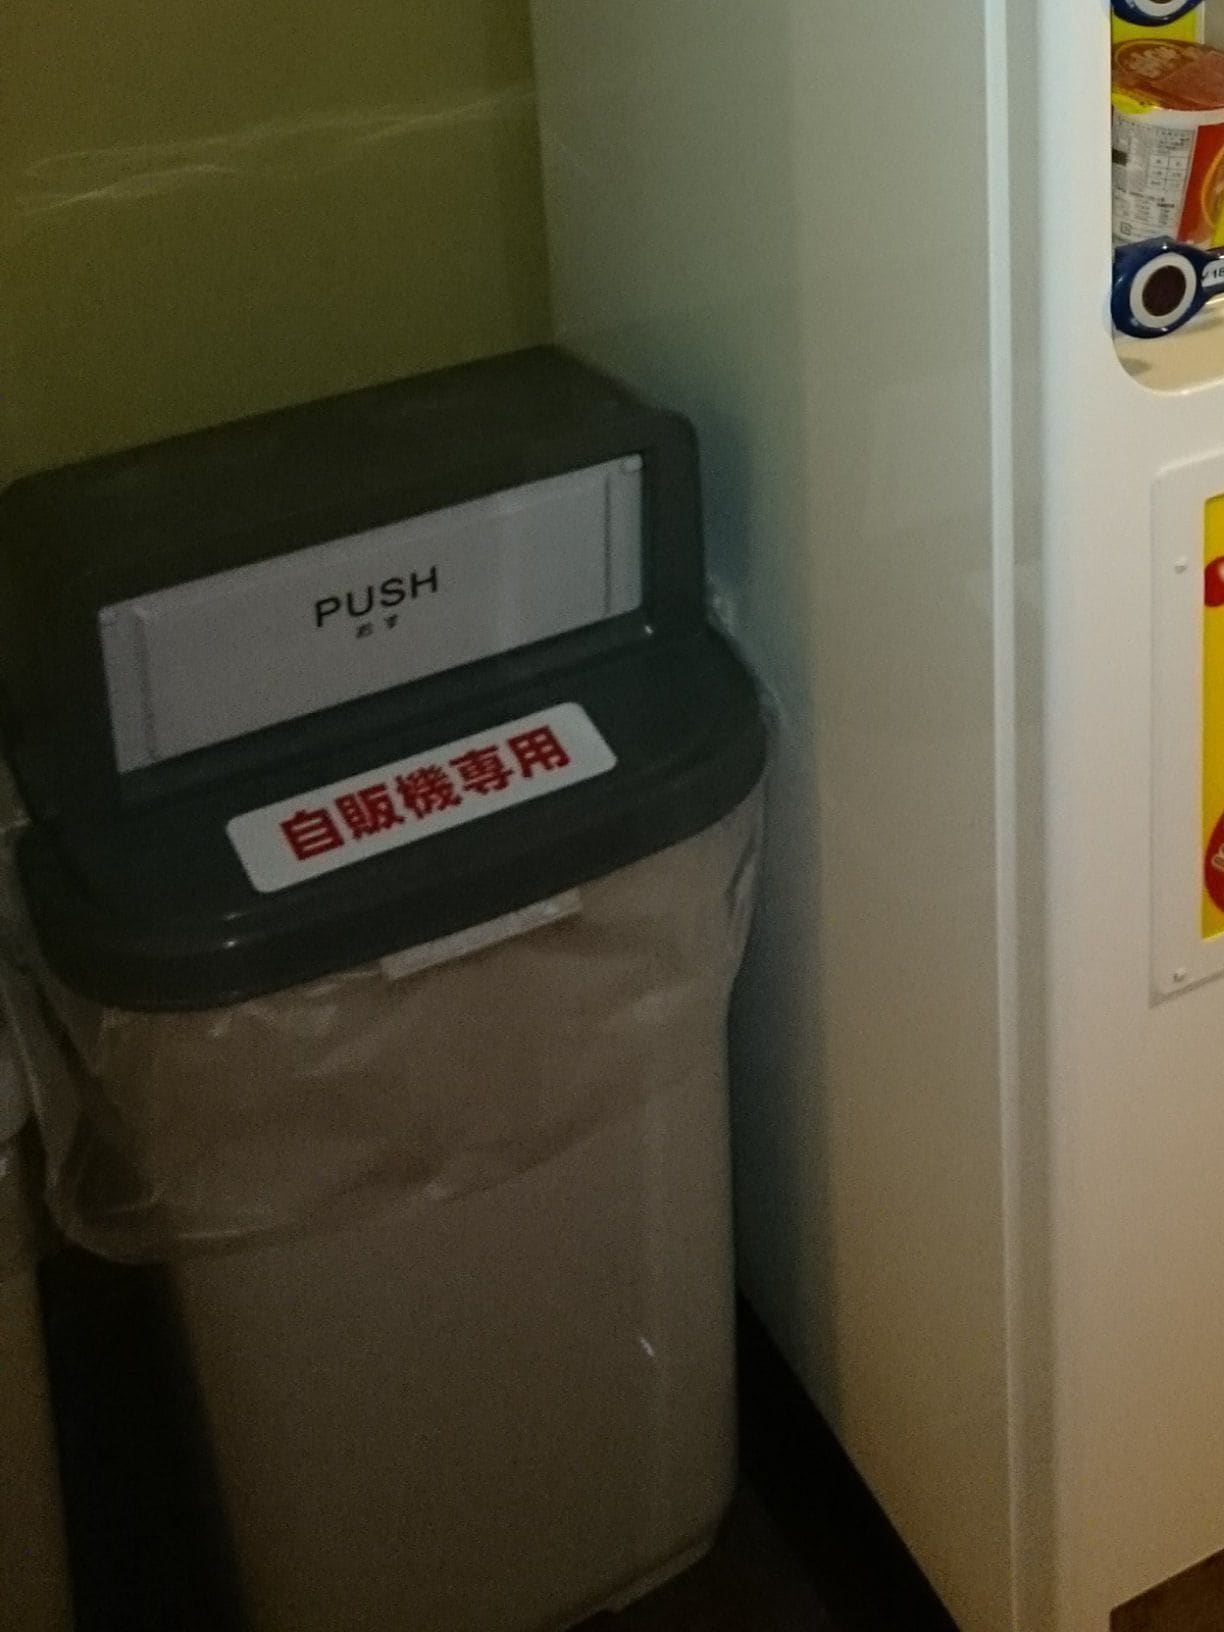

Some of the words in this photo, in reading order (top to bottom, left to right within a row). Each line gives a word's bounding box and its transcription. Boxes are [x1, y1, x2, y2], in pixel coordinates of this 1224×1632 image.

[316, 565, 437, 628] PUSH
[281, 725, 570, 860] 自販機専用
